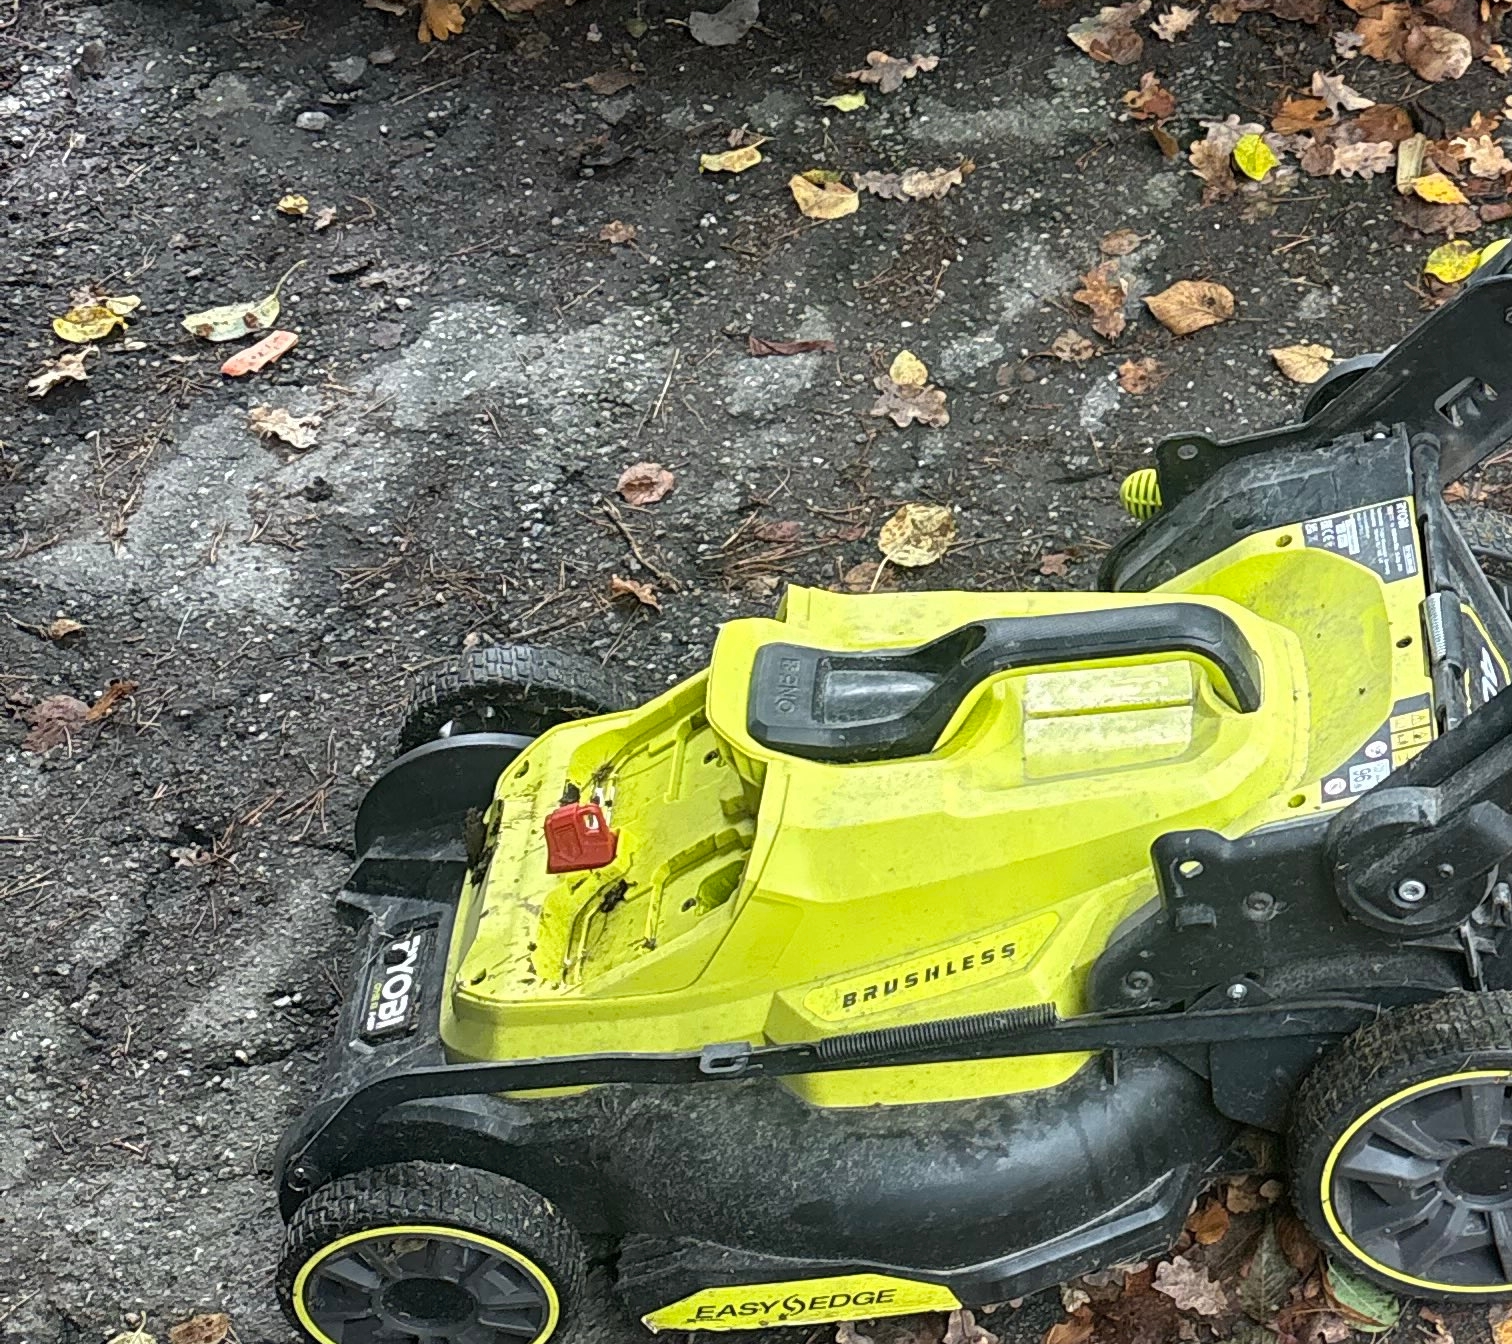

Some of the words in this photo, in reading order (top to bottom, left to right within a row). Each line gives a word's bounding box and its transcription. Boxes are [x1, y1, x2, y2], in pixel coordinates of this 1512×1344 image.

[842, 942, 1016, 1008] BRUSHLESS
[695, 1300, 781, 1320] EASY
[808, 1289, 897, 1311] EDGE
